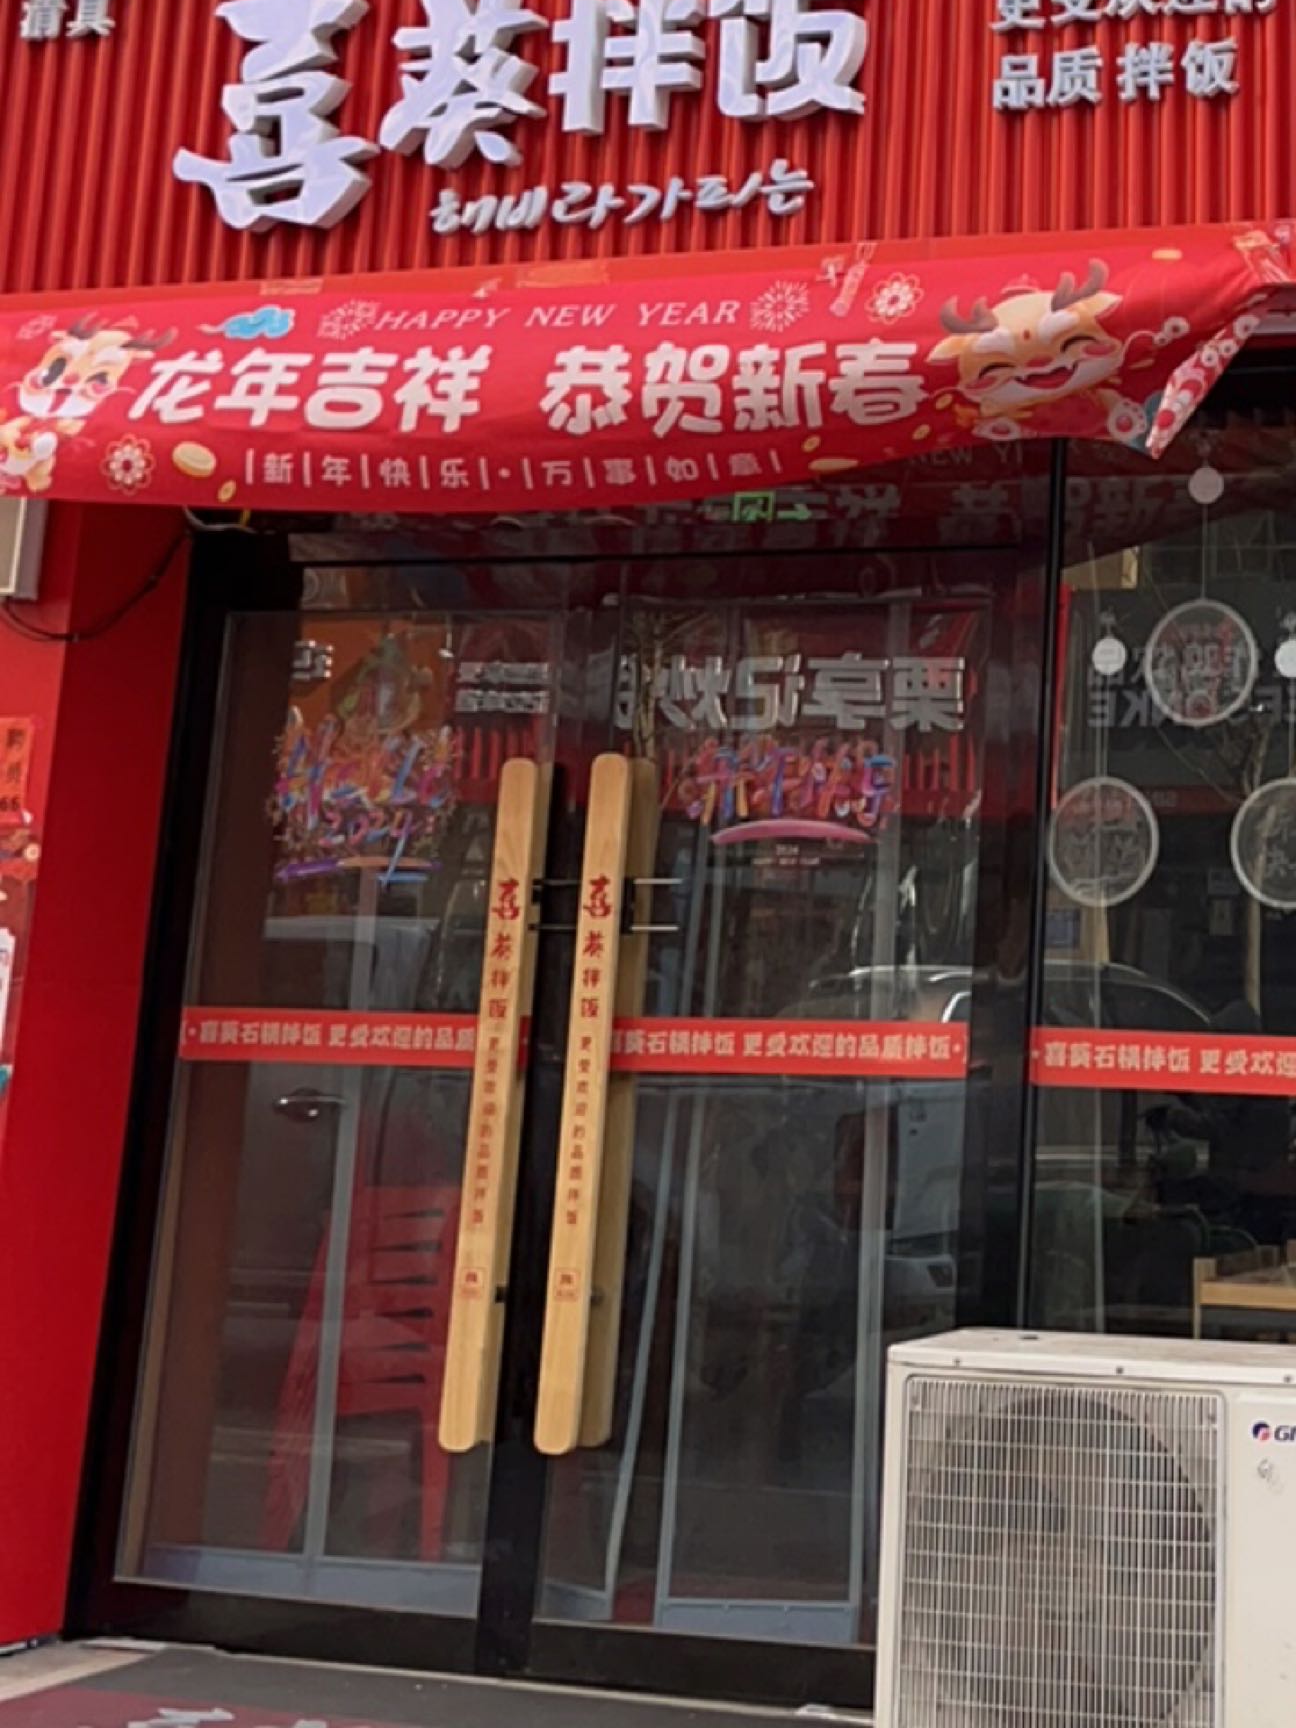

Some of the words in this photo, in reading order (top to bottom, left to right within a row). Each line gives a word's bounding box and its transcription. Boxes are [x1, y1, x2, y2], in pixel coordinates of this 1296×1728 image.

[991, 35, 1241, 111] 品质拌饭
[373, 307, 511, 332] HAPPY
[524, 303, 616, 328] NEW
[636, 298, 741, 327] YEAR
[128, 343, 492, 434] 龙年吉祥
[540, 336, 928, 439] 恭贺新春
